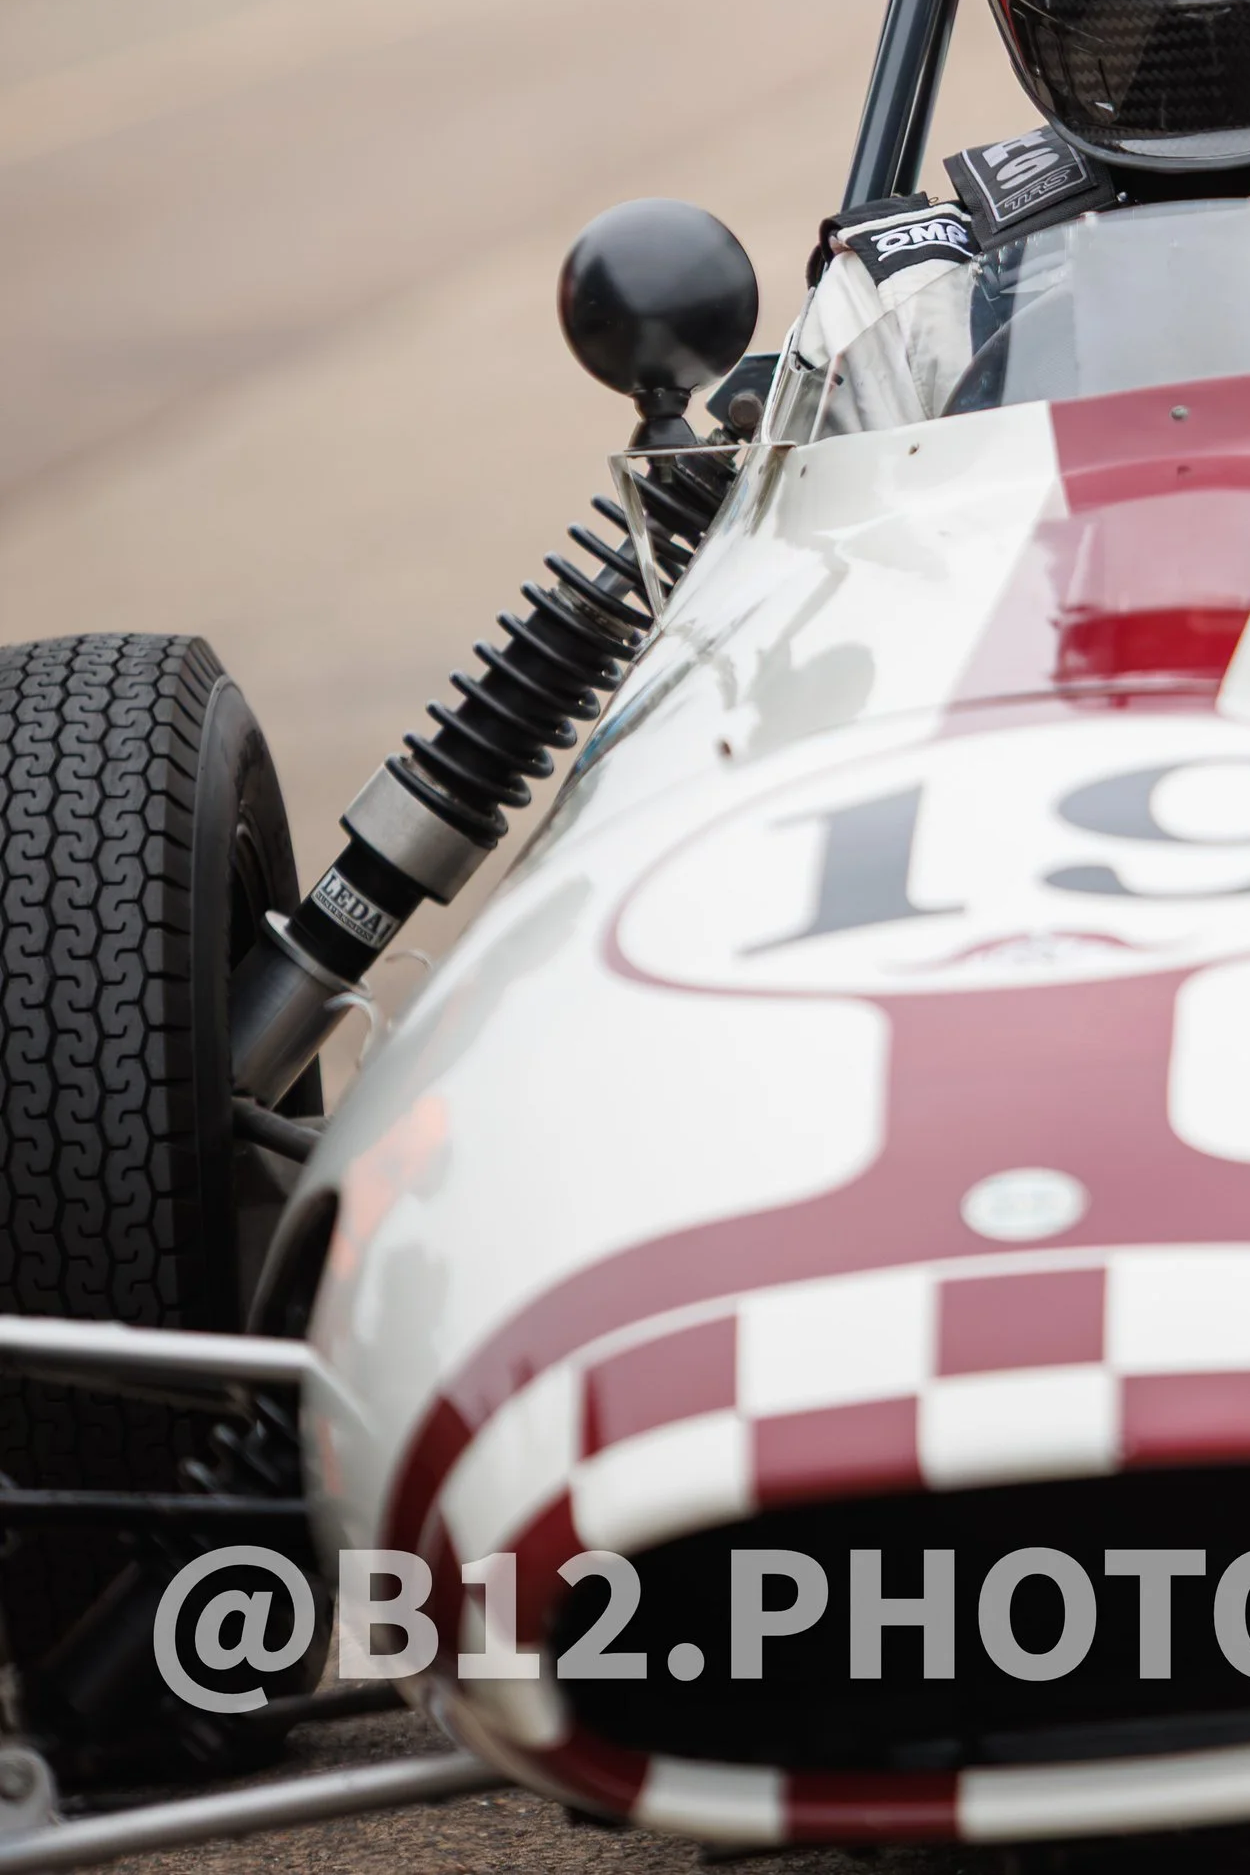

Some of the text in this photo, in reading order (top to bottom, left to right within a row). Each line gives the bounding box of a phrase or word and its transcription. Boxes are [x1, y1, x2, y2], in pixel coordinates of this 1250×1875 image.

[1004, 169, 1071, 210] TRS
[876, 222, 969, 253] OMP
[321, 873, 383, 935] LEDA
